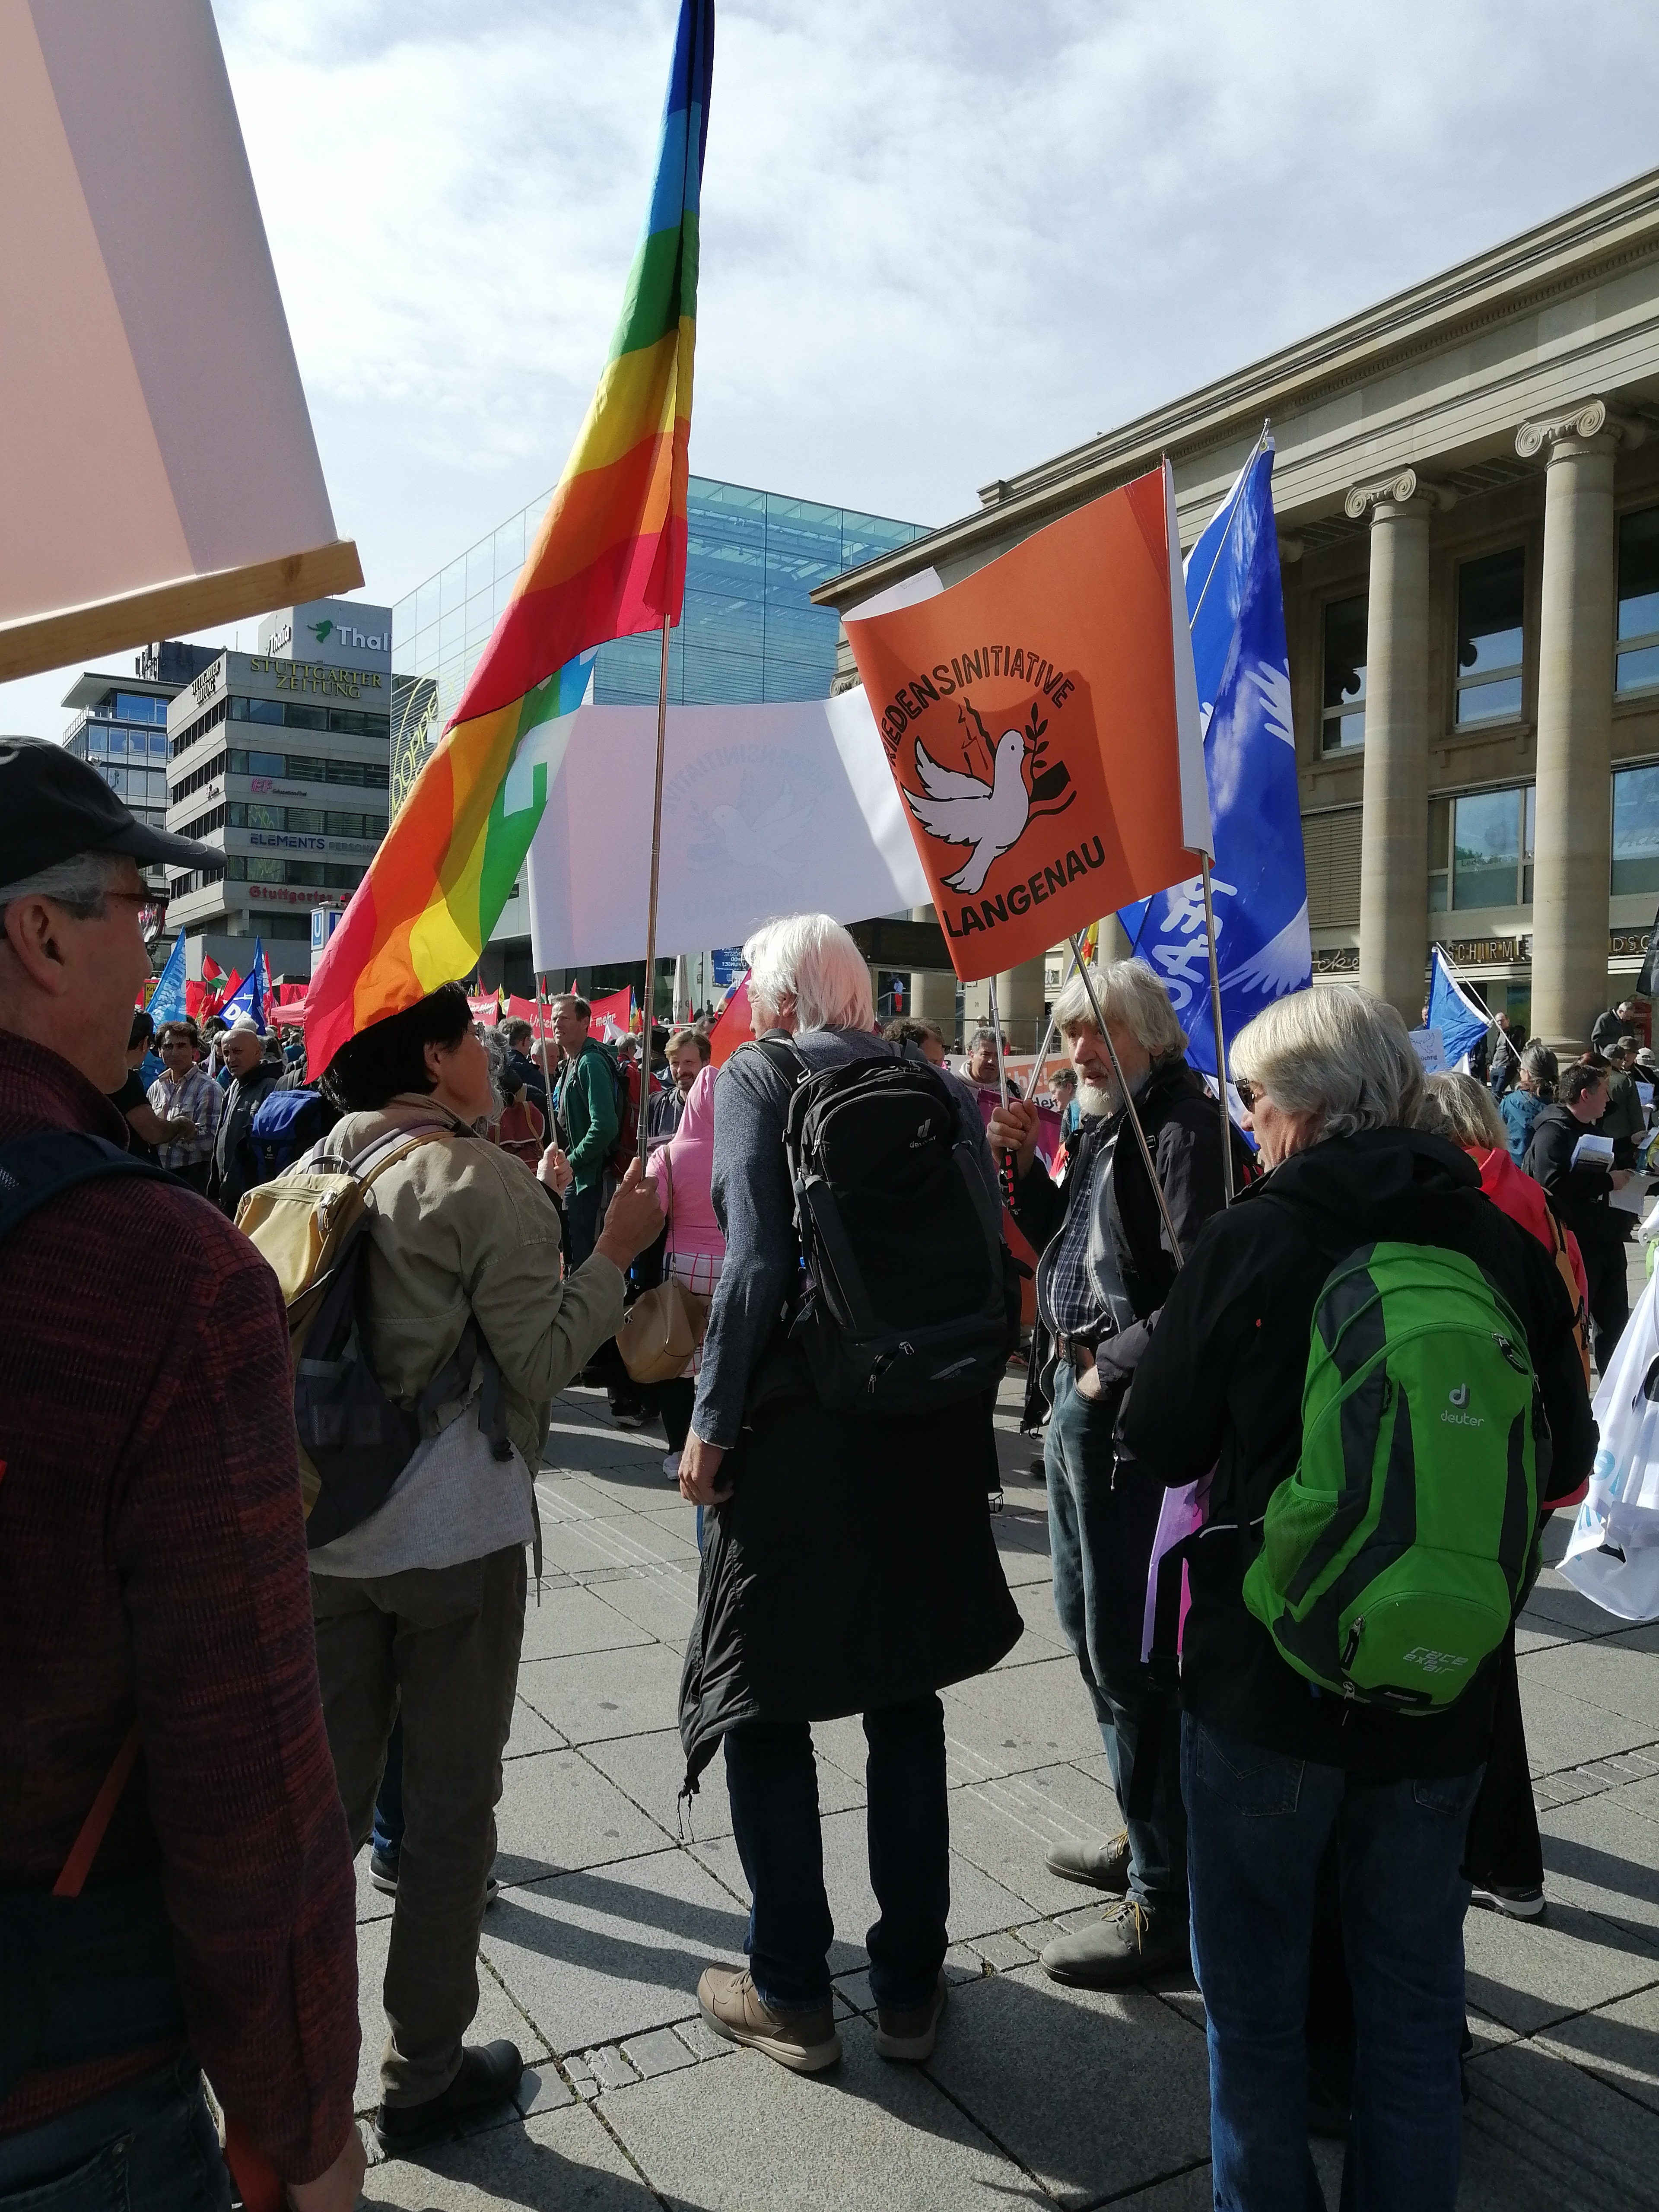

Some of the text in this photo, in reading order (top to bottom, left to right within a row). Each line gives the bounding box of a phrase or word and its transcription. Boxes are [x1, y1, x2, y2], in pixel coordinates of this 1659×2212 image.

[270, 623, 291, 653] Thalia
[336, 626, 391, 652] Thal
[191, 660, 221, 696] STUTTGARTER
[251, 657, 382, 688] STUTTGARTER
[195, 678, 216, 705] ZEITUNG
[276, 674, 360, 698] ZEITUNG
[882, 645, 1075, 781] RIEDENSINITIATIVE
[251, 833, 325, 849] ELEMENTS
[249, 886, 333, 903] Stuttgarter
[943, 835, 1106, 938] LANGENAU
[314, 914, 321, 938] U
[1441, 1410, 1485, 1427] deuter
